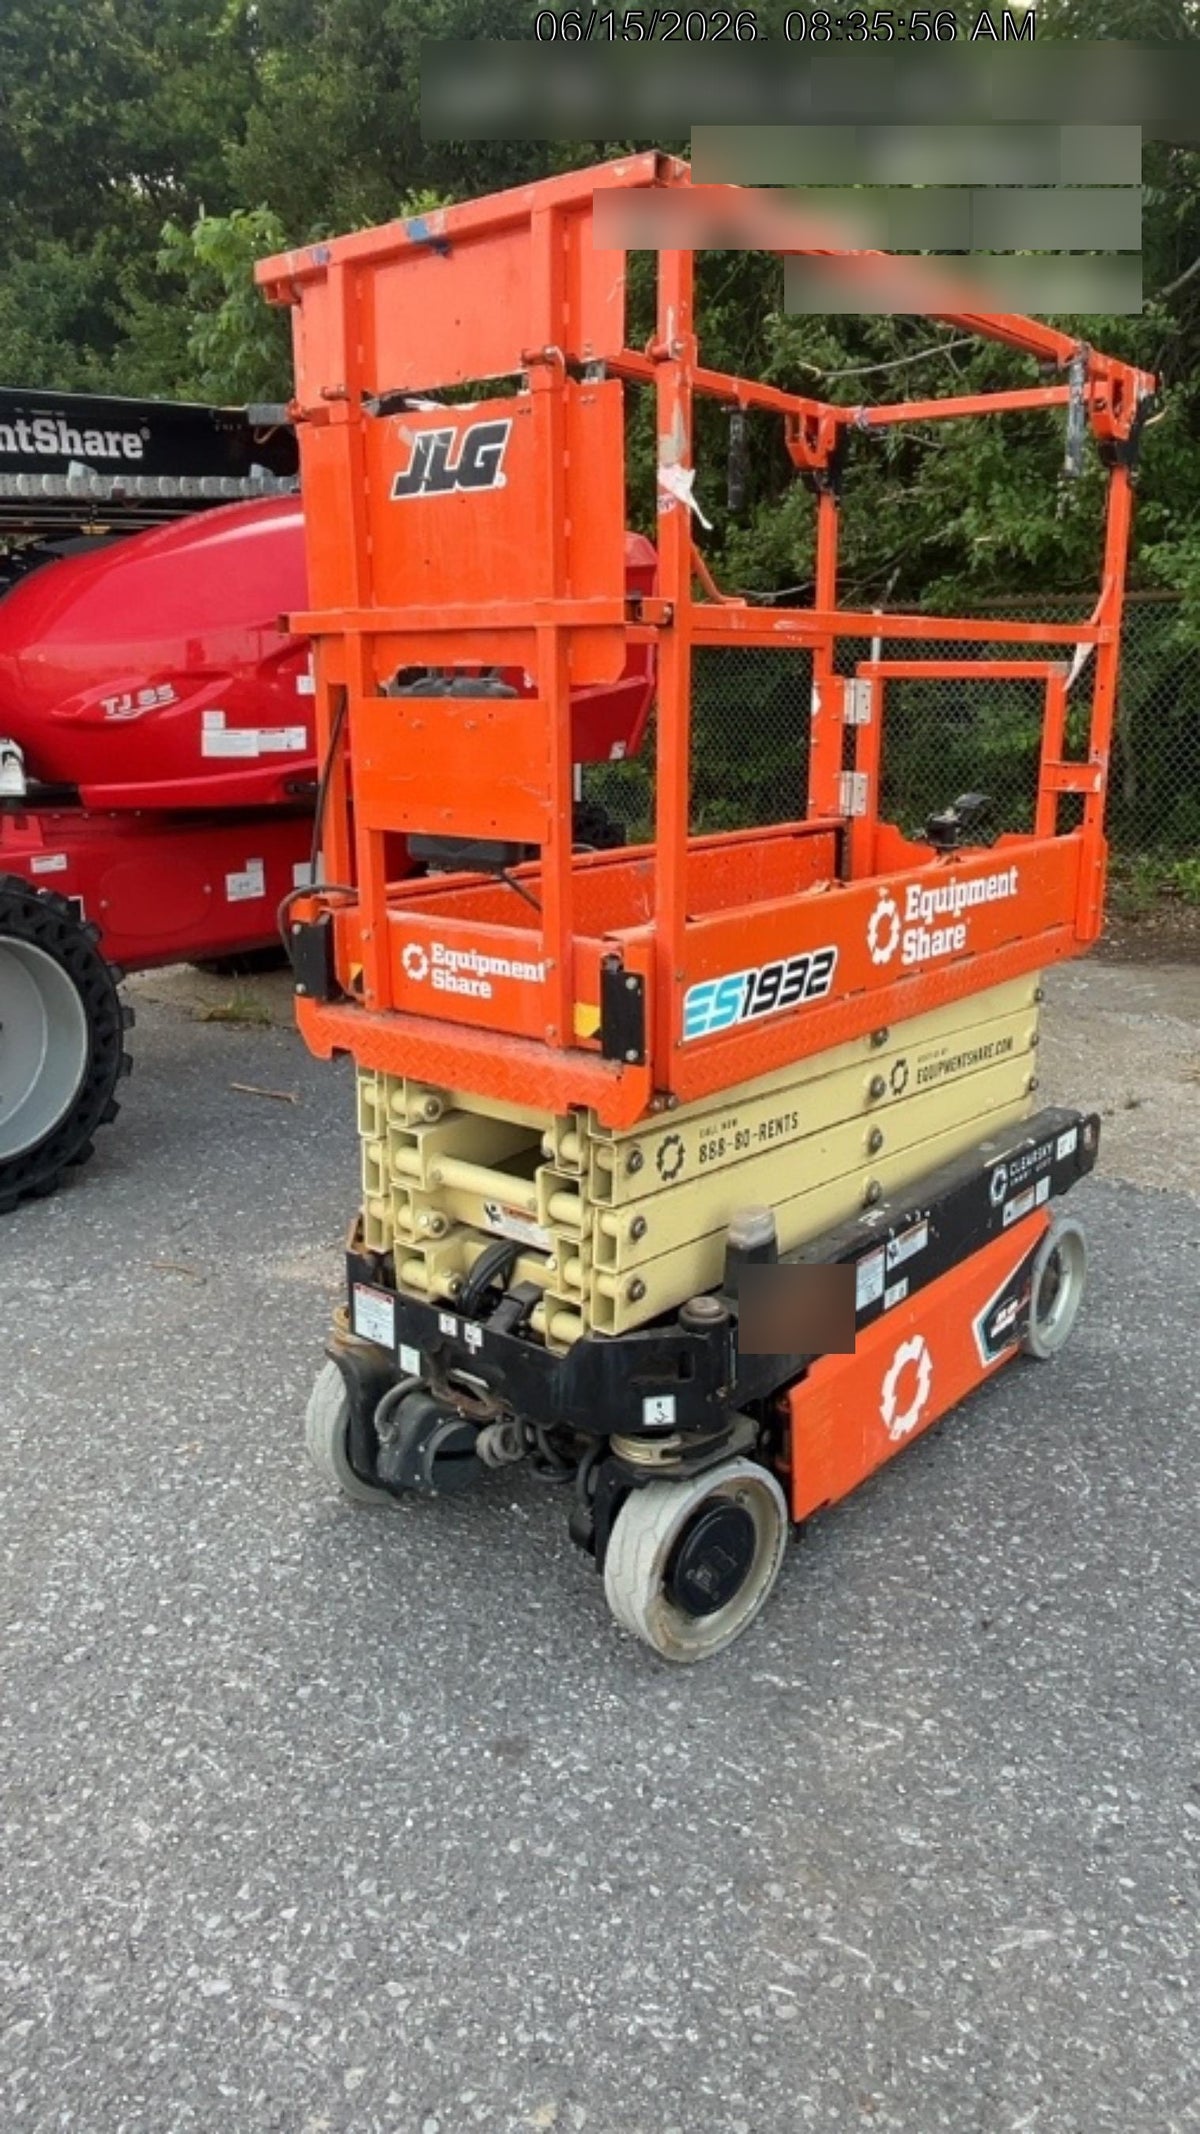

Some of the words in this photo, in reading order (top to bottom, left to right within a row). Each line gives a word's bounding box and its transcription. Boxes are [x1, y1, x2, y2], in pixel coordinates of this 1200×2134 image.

[390, 418, 513, 500] JLG
[901, 865, 1018, 925] Equipment
[431, 942, 546, 982] Equipment
[901, 924, 966, 966] Share
[431, 969, 492, 998] Share
[683, 945, 838, 1041] ES1932
